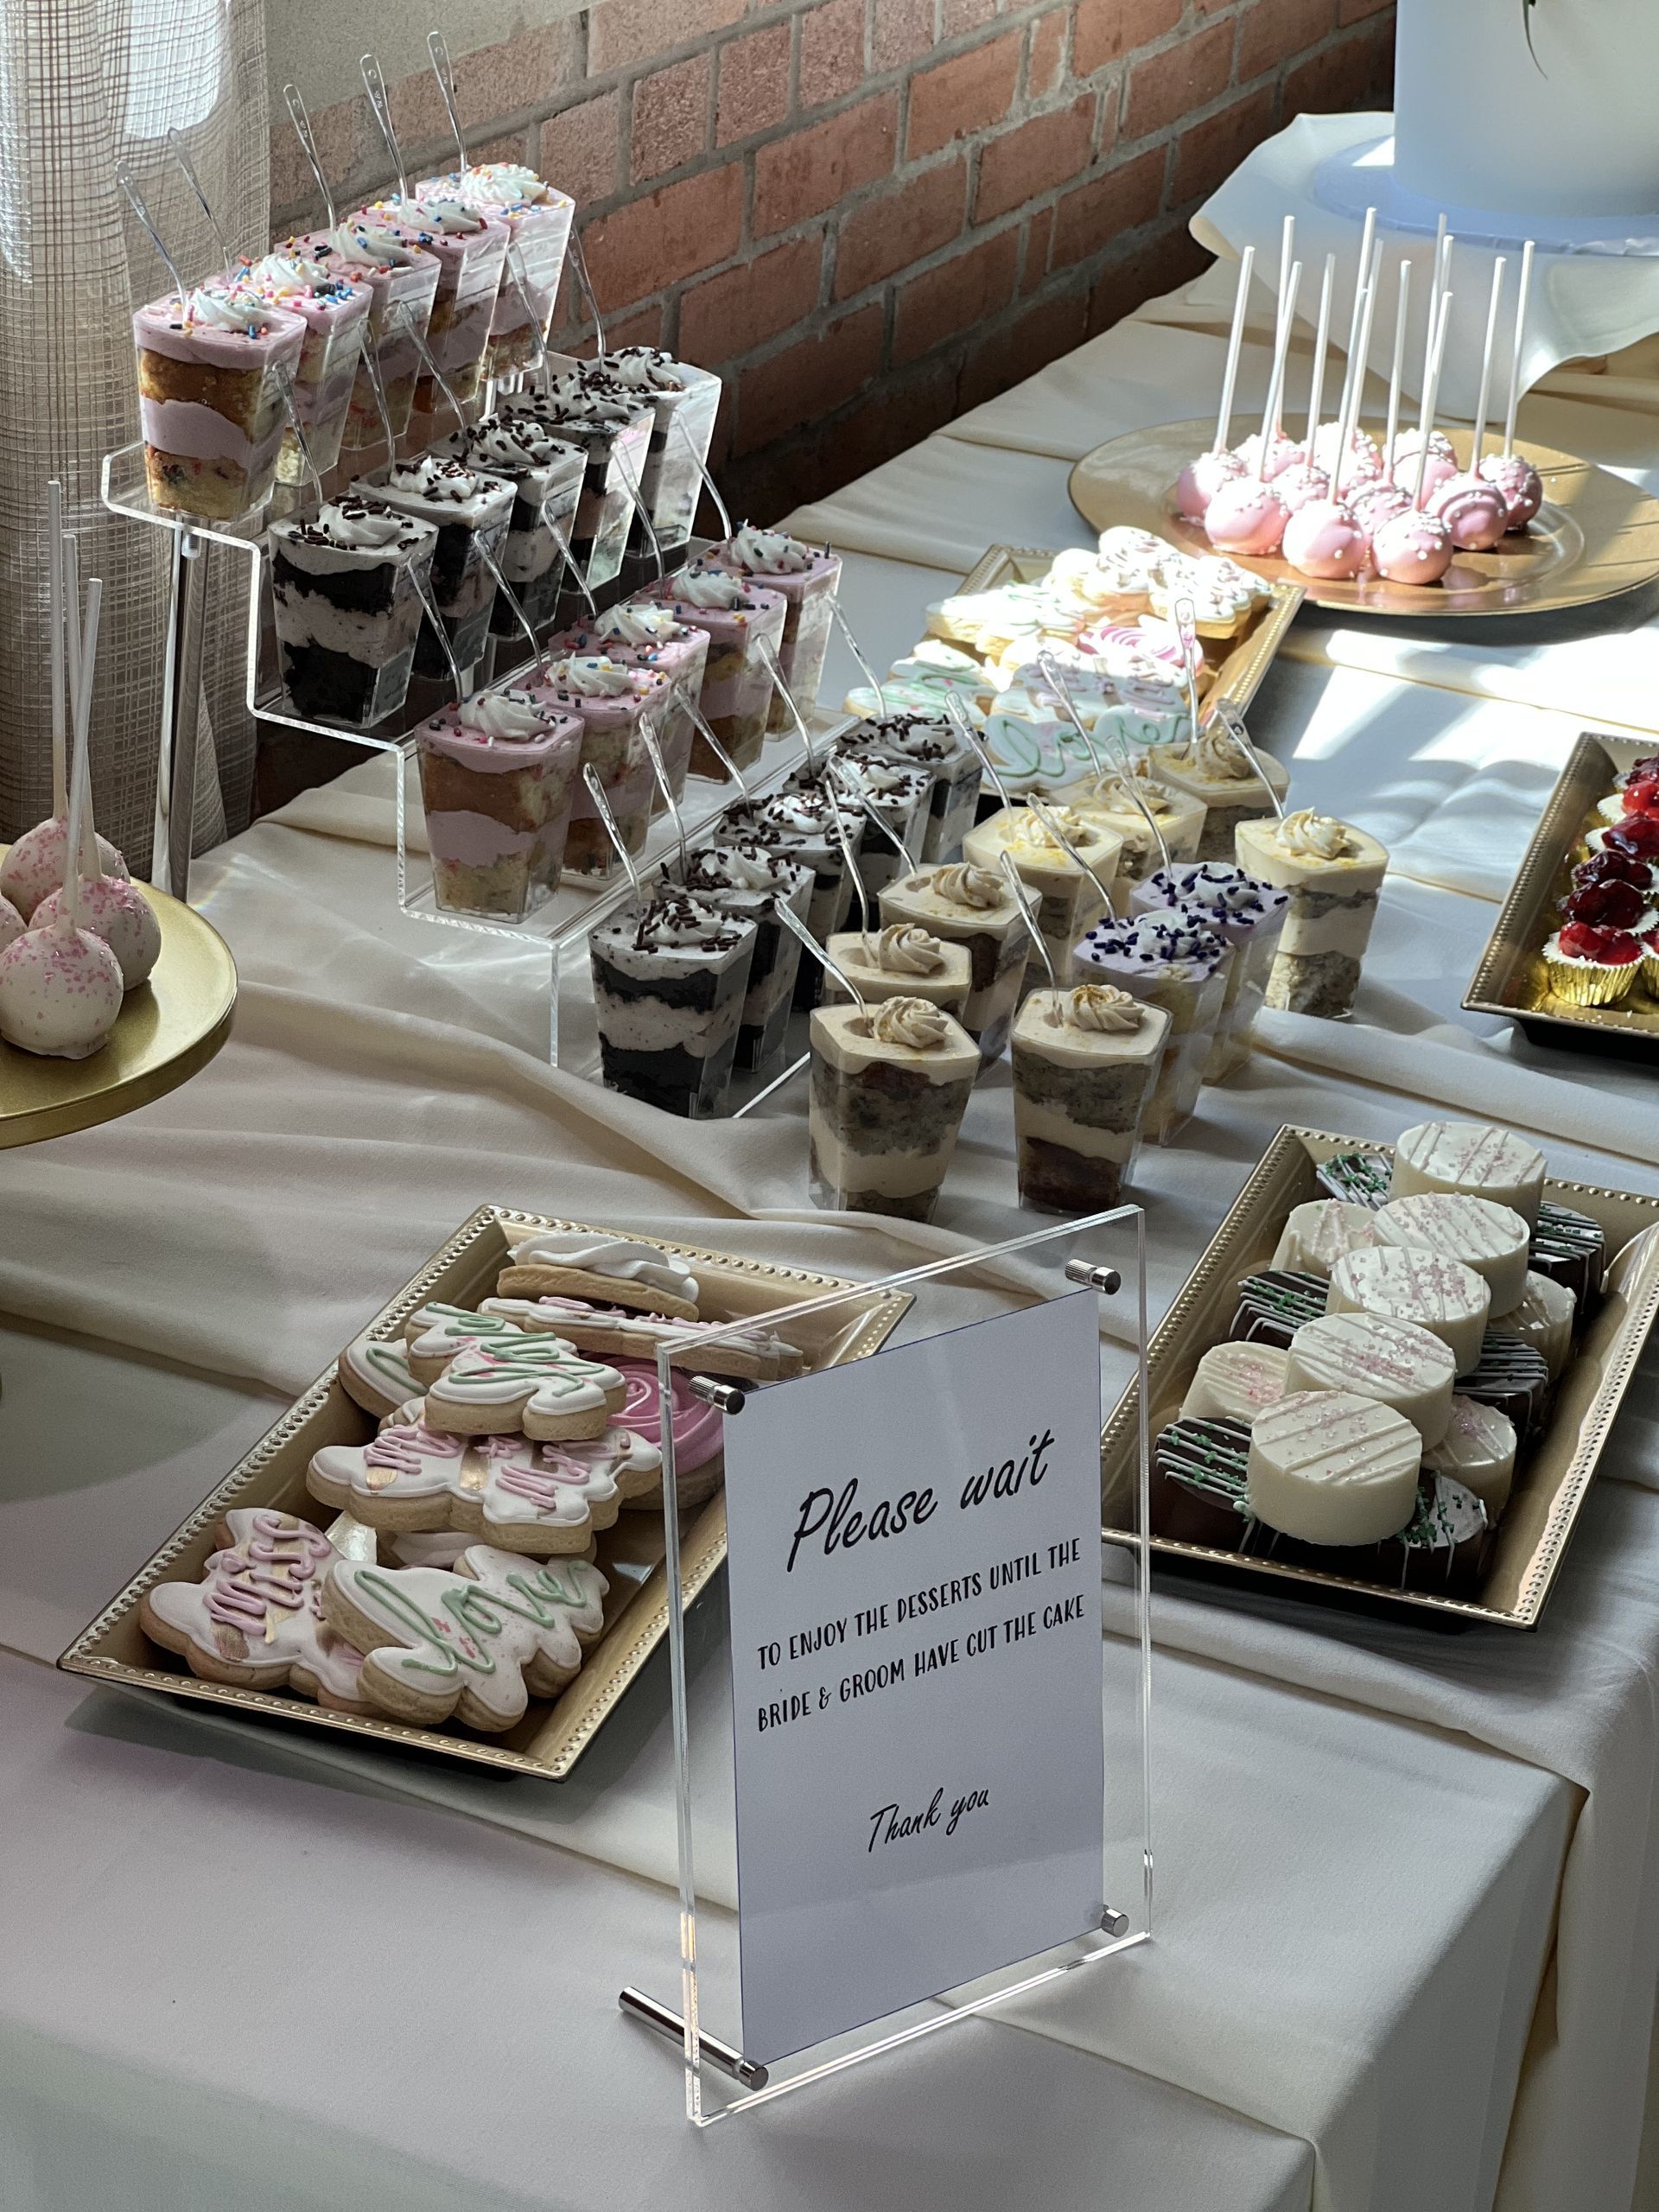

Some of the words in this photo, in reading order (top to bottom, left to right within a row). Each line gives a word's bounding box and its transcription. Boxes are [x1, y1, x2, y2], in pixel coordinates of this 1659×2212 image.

[786, 1477, 938, 1573] Please
[959, 1428, 1055, 1510] wait
[353, 1560, 588, 1676] love
[757, 1642, 781, 1671] TO
[789, 1617, 848, 1661] ENJOY
[854, 1604, 890, 1637] THE
[897, 1572, 982, 1624] DESSERTS
[989, 1552, 1042, 1591] UNTIL
[1046, 1537, 1081, 1570] THE
[758, 1691, 812, 1732] BRIDE
[818, 1686, 833, 1710] &
[839, 1658, 906, 1703] GROOM
[914, 1638, 960, 1678] HAVE
[966, 1624, 998, 1657] CUT
[1002, 1611, 1037, 1644] THE
[1042, 1593, 1085, 1630] CAKE
[868, 1787, 944, 1853] Thank
[945, 1789, 989, 1836] you
